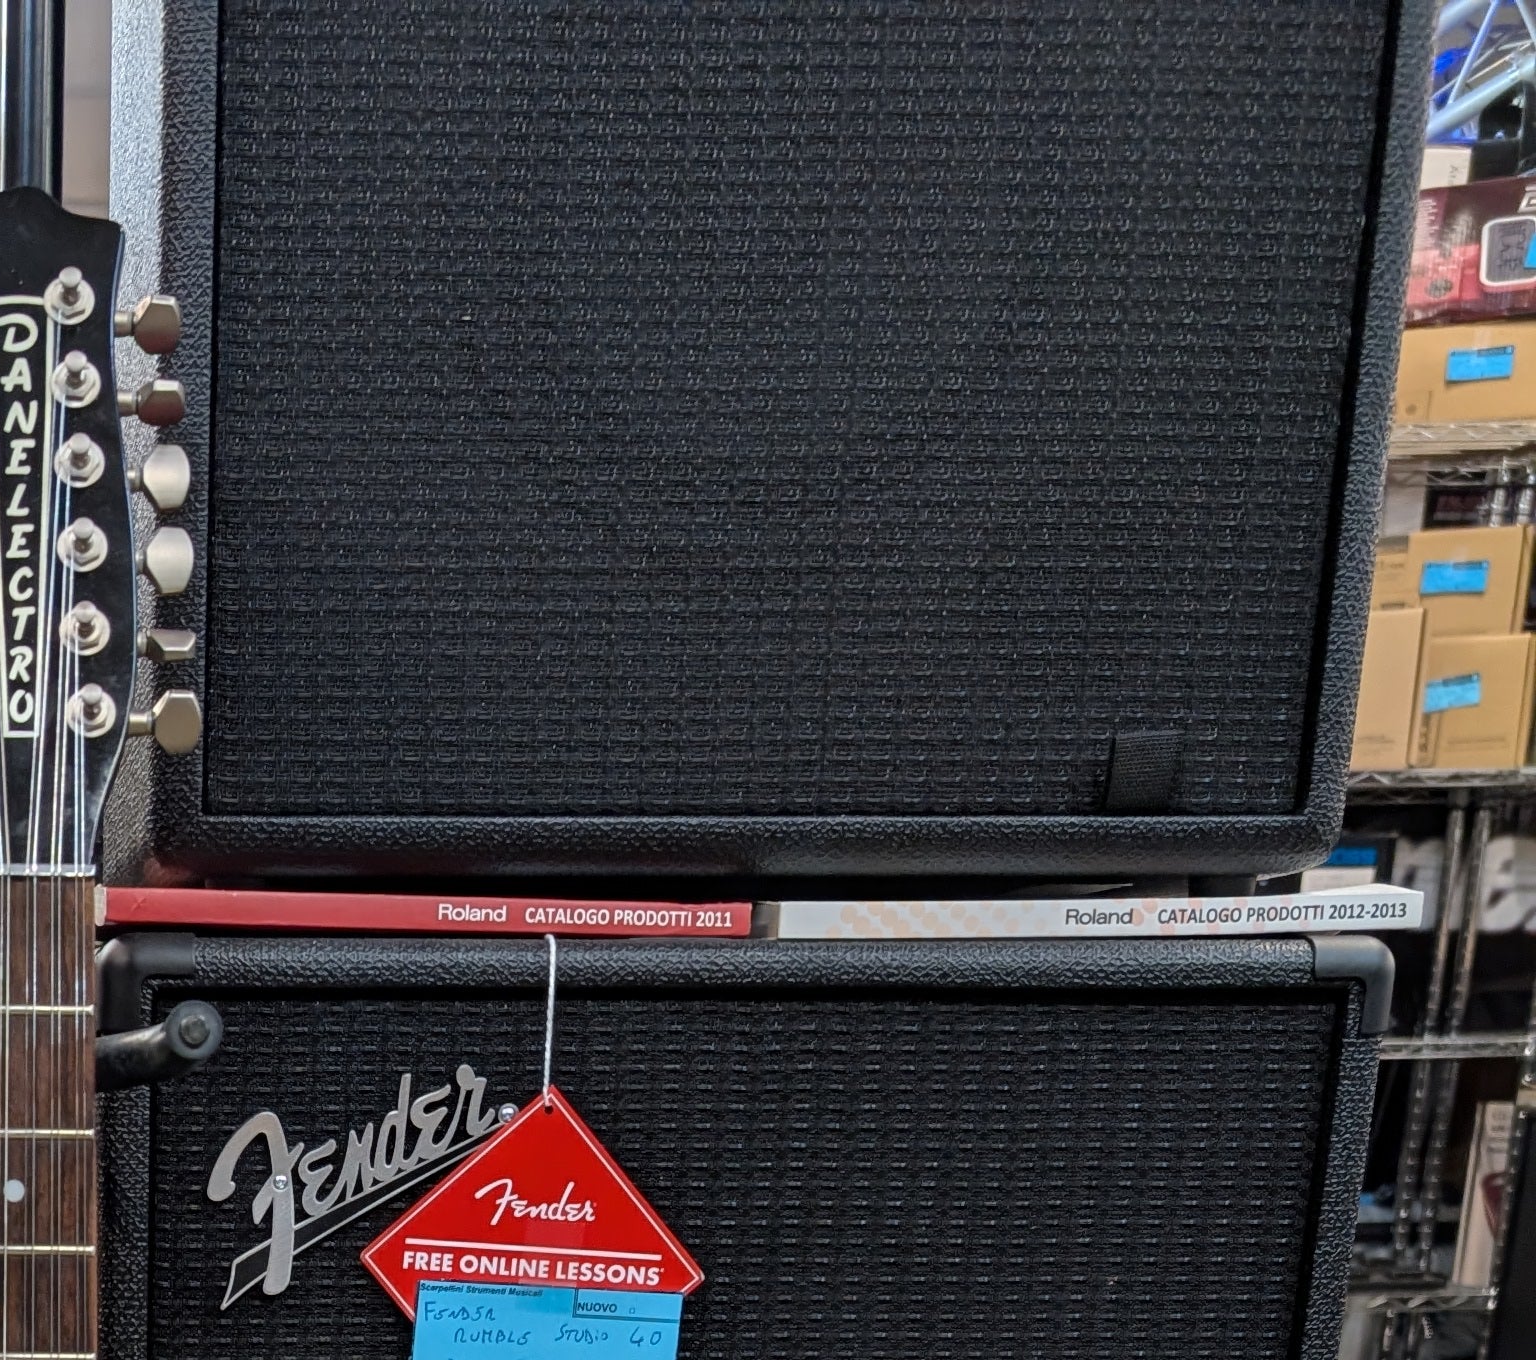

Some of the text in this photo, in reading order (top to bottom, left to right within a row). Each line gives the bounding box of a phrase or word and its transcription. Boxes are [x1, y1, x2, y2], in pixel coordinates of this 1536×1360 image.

[438, 903, 733, 928] Roland CATALOGO PRODOTTI 2011
[1064, 902, 1408, 926] Roland CATALOGO PRODOTTI 2012-2013
[207, 1064, 495, 1296] Fender
[474, 1178, 597, 1226] Fender
[402, 1251, 664, 1286] FREE ONLINE LESSONS
[466, 1285, 506, 1296] Strumenti
[577, 1302, 618, 1314] NUOVO
[629, 1326, 662, 1347] 40
